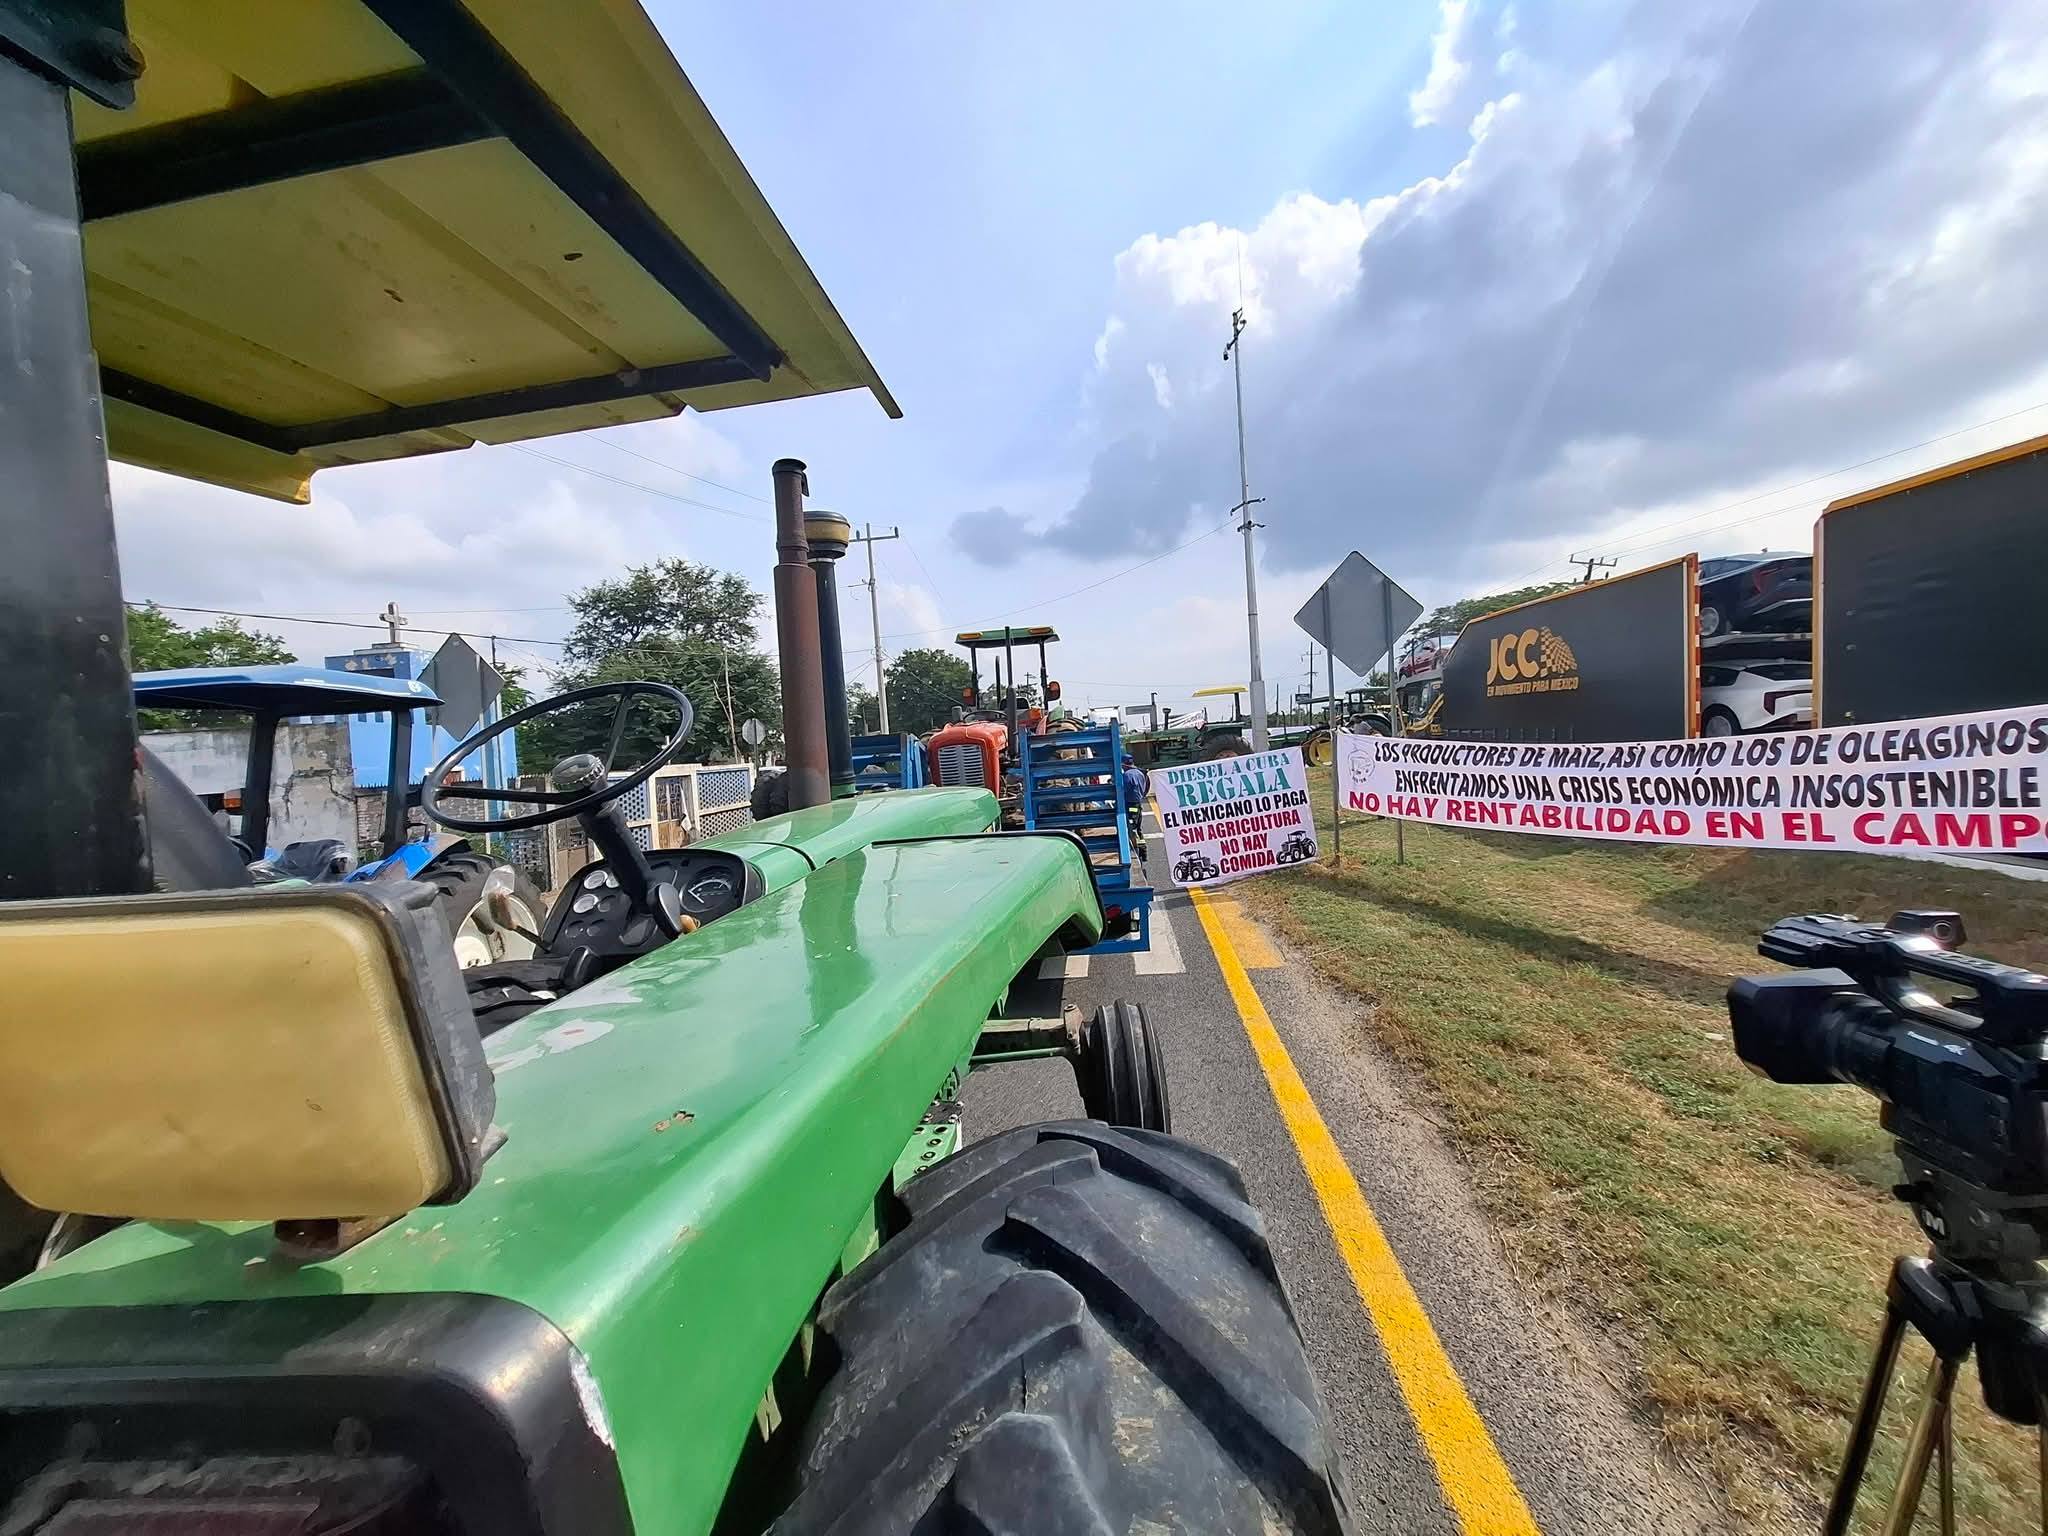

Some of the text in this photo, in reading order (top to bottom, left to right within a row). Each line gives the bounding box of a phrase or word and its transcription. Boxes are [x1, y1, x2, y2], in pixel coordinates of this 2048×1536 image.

[1486, 628, 1540, 685] JCC
[1168, 752, 1290, 785] DIESEL A CUBA
[1374, 741, 1400, 763] LOS
[1401, 743, 1517, 768] PRODUCTORES
[1519, 747, 1545, 768] DE
[1649, 740, 1727, 768] COMO
[1732, 738, 1787, 766] LOS
[1790, 733, 1832, 765] DE
[1175, 768, 1292, 807] REGALA
[1395, 767, 2040, 809] ENFRENTAMOS UNA CRISIS ECONÓMICA INSOSTENIBLE
[1164, 790, 1308, 828] EL MEXICANO LO PAGA
[1179, 809, 1302, 845] SIN AGRICULTURA
[1349, 791, 2048, 848] NO HAY RENTABILIDAD EN EL CAMP
[1220, 833, 1269, 856] NO HAY
[1220, 850, 1276, 875] COMIDA
